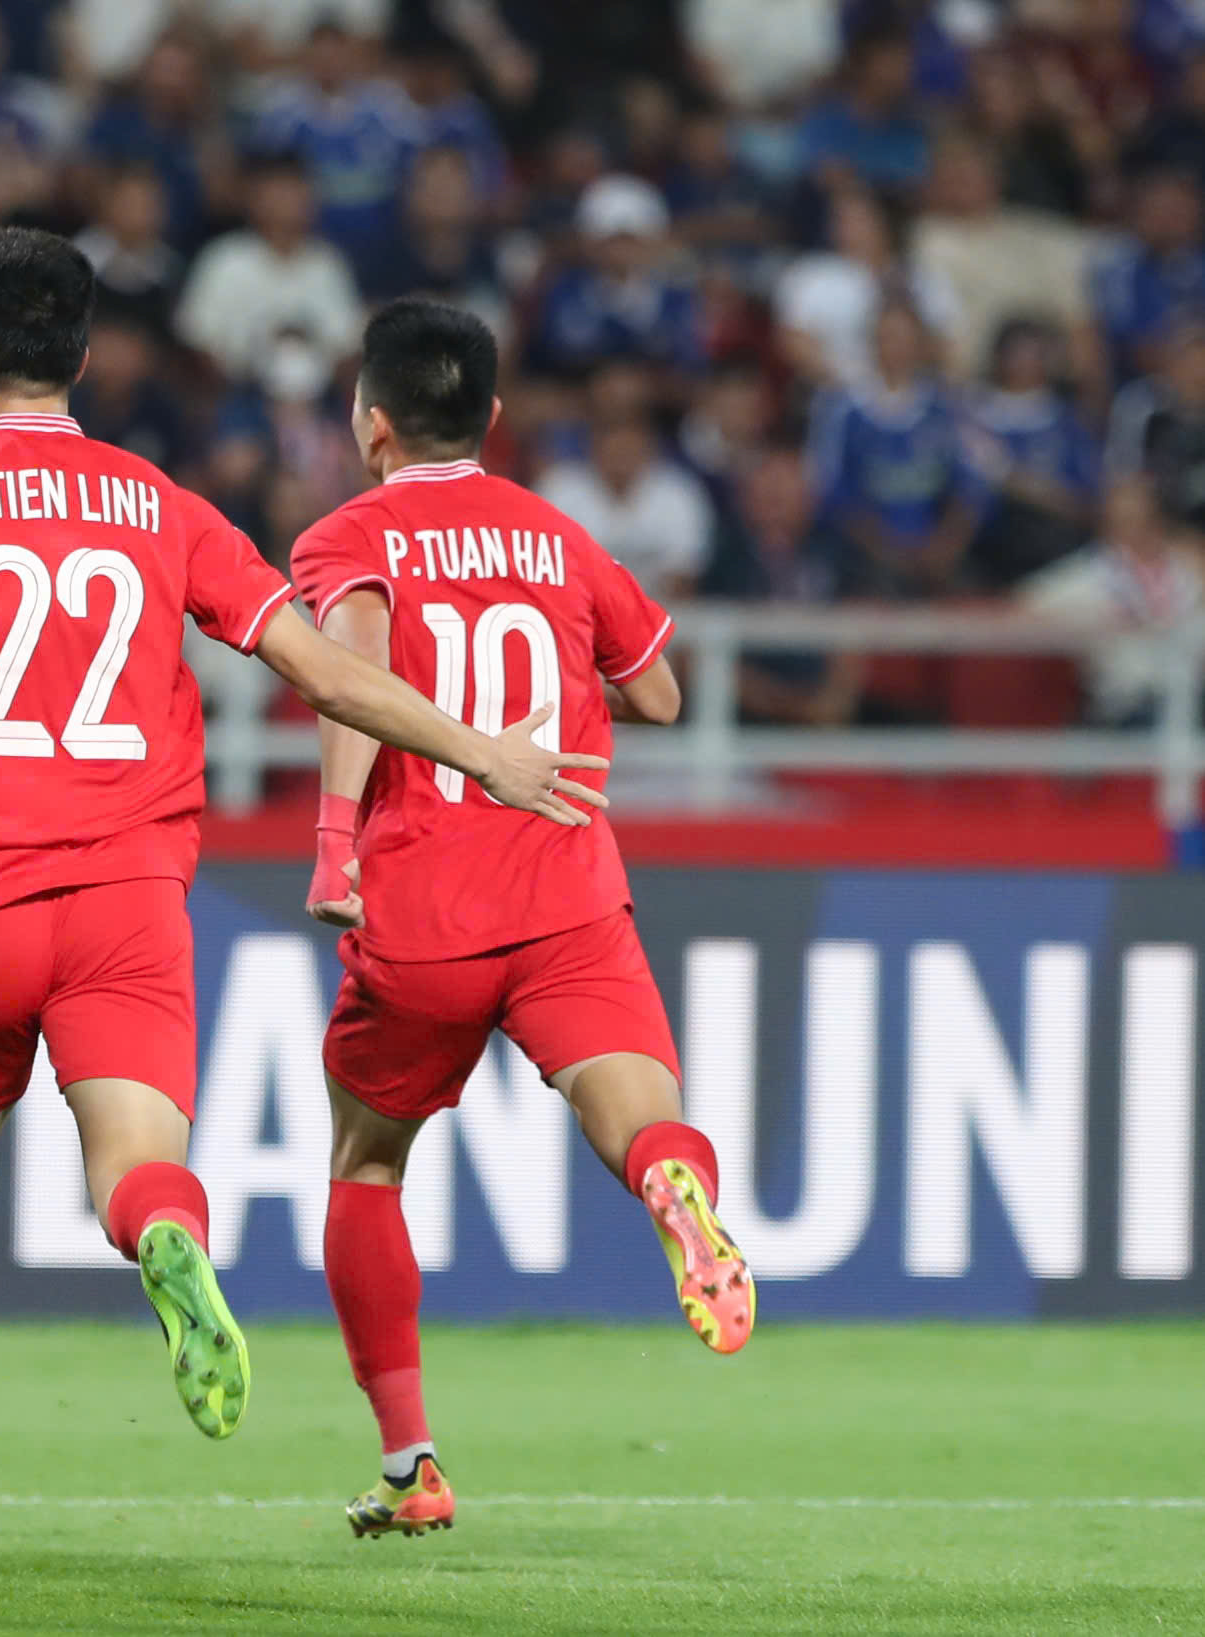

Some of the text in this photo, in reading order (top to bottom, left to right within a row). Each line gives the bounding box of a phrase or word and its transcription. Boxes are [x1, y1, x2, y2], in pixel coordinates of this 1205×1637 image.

[77, 473, 160, 534] LINH
[511, 529, 566, 587] HAI
[421, 602, 562, 806] 10
